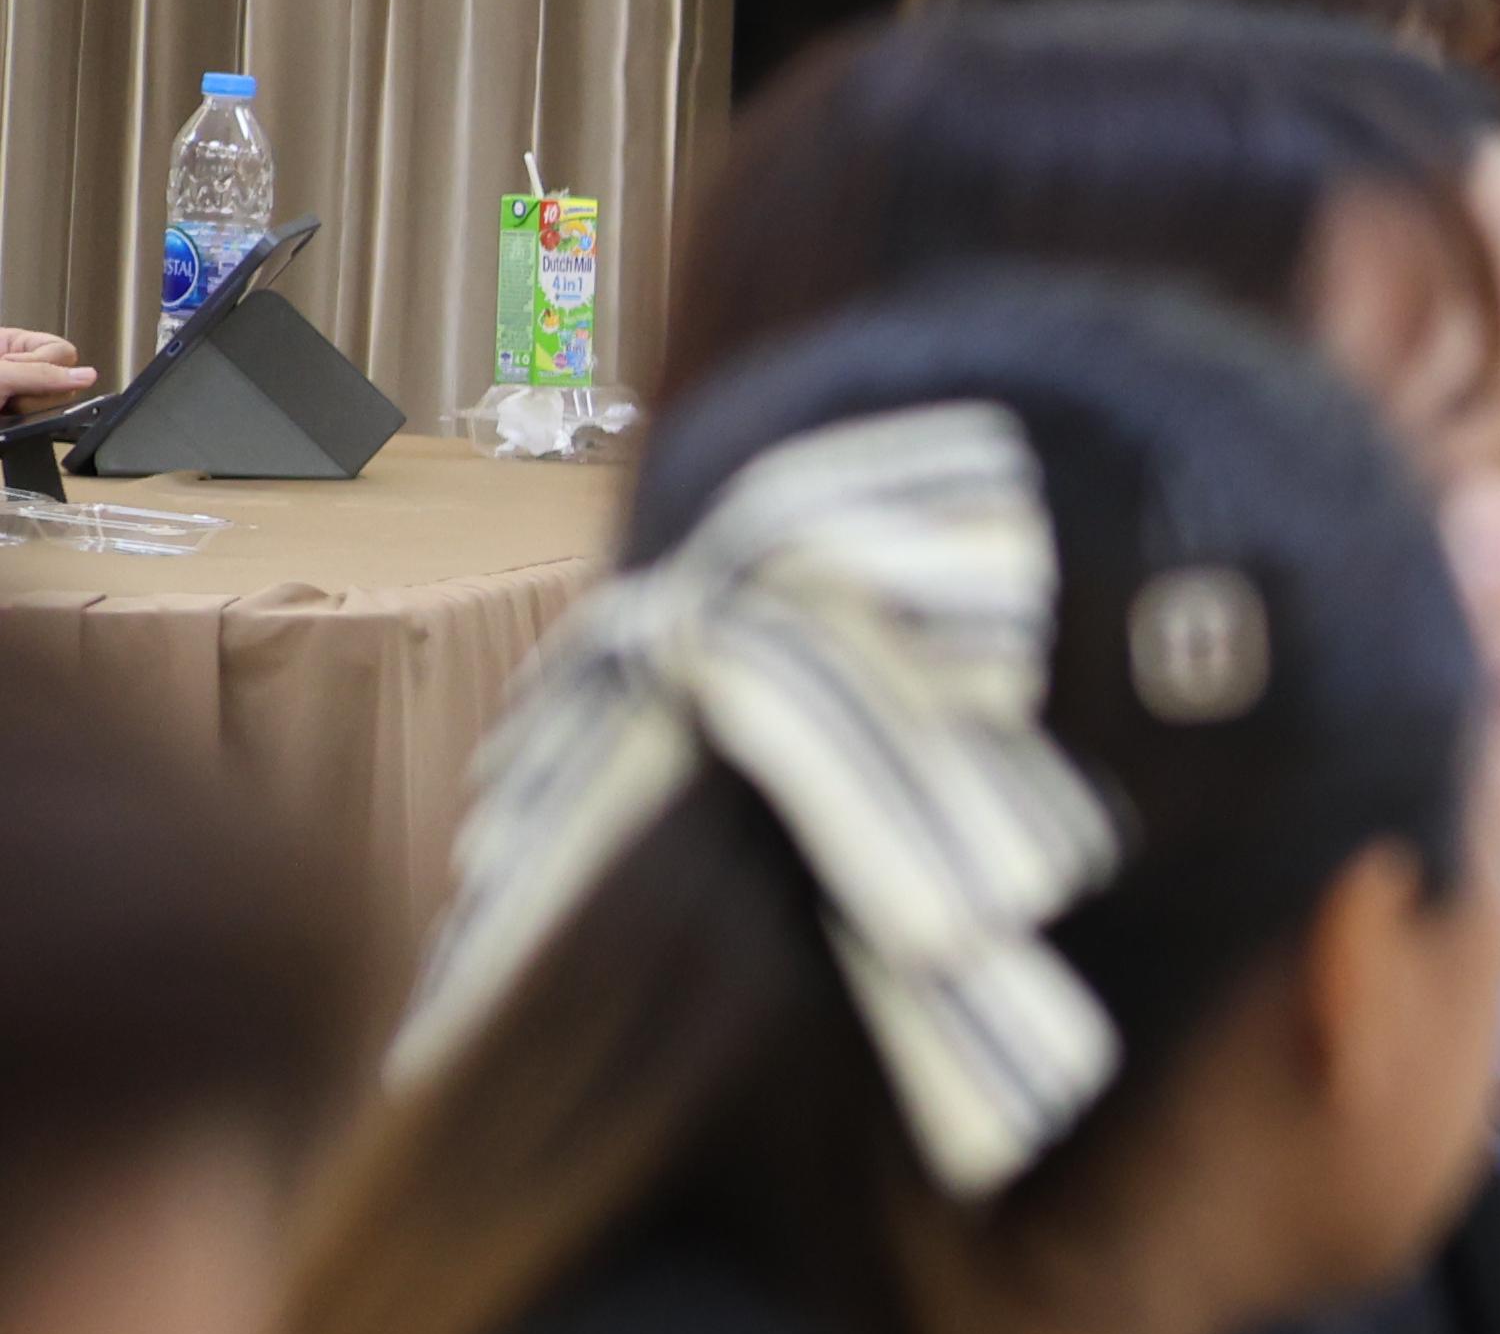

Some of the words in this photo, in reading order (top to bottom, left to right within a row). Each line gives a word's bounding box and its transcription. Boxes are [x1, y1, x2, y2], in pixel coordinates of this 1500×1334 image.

[542, 255, 573, 273] Dutch
[574, 256, 592, 273] Mill
[552, 275, 560, 291] 4
[563, 276, 576, 291] in
[577, 276, 583, 292] 1
